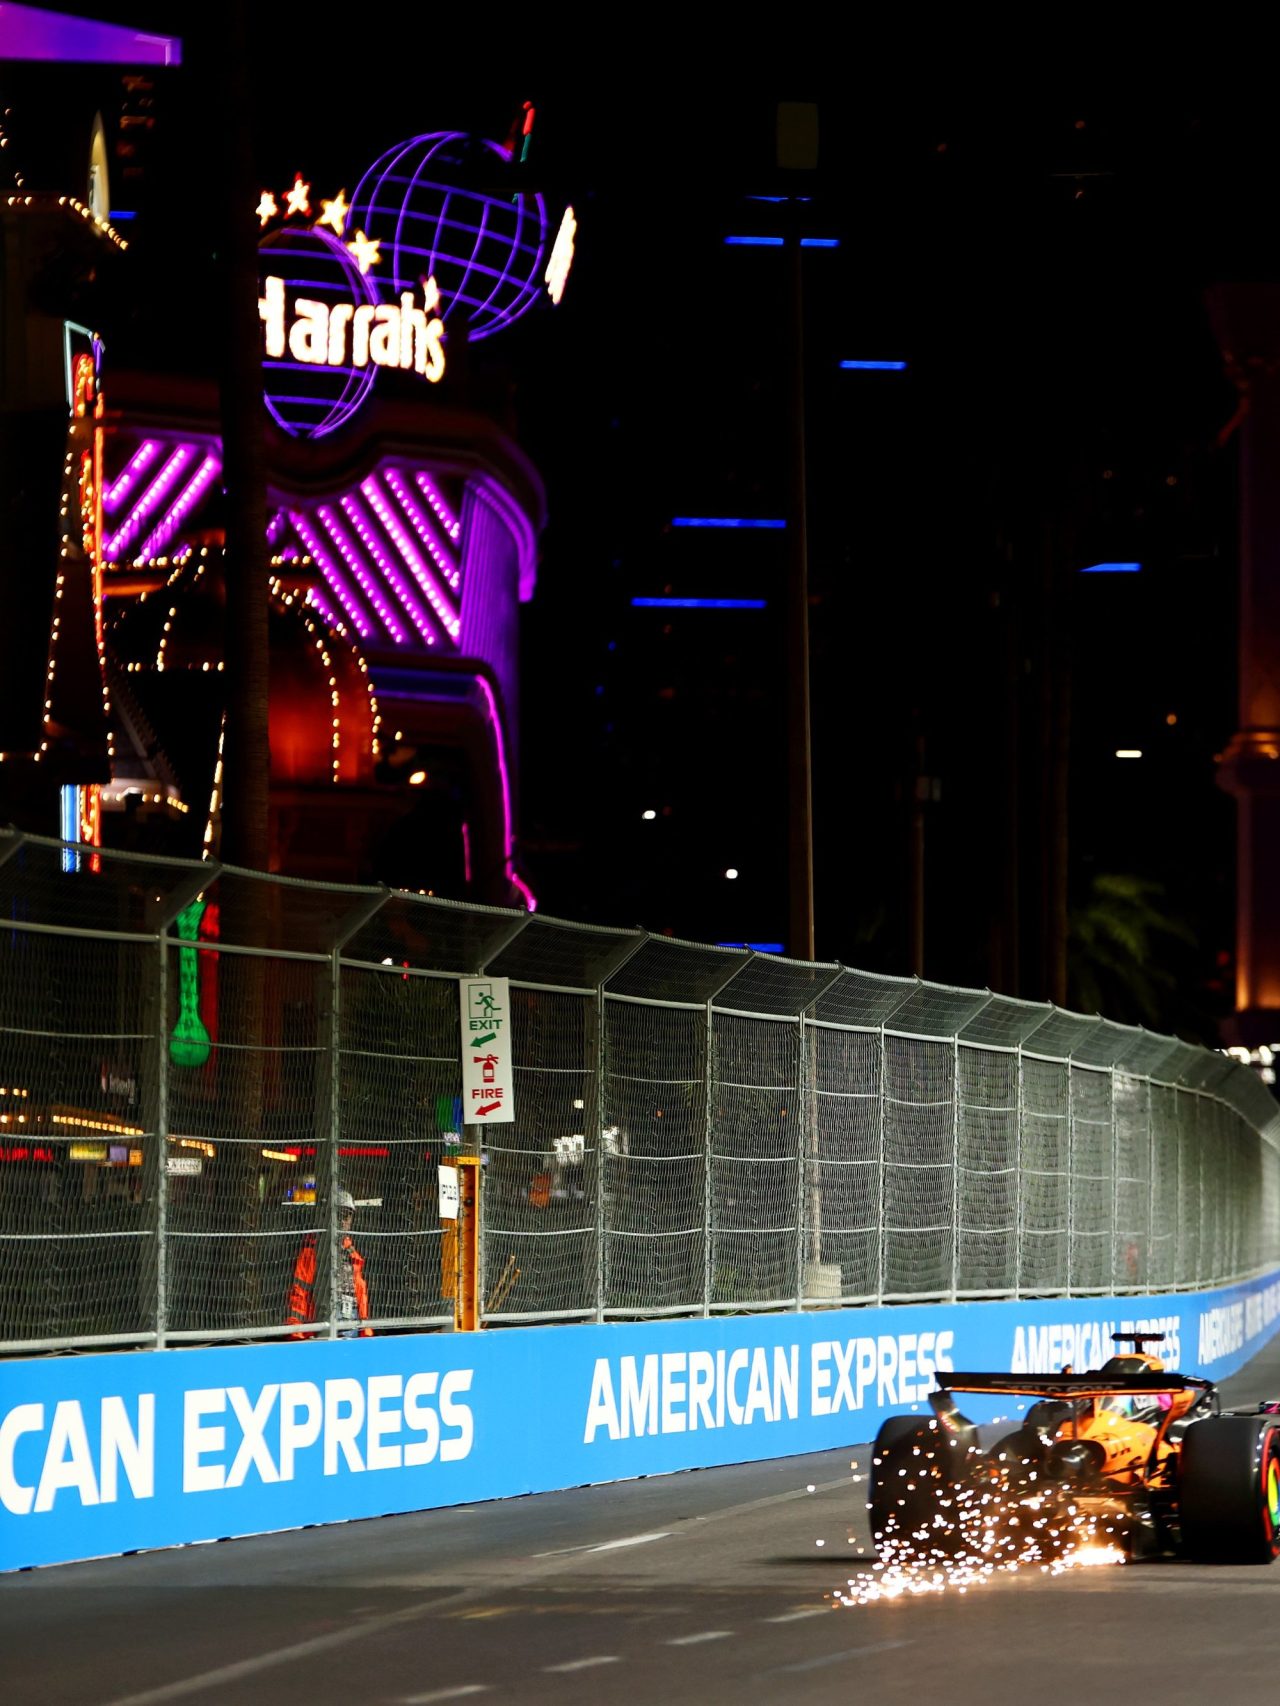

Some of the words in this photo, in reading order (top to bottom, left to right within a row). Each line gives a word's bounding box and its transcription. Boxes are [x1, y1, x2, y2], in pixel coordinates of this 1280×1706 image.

[469, 1019, 503, 1031] EXIT
[471, 1087, 504, 1100] FIRE
[1010, 1321, 1116, 1375] AMERICAN
[583, 1344, 800, 1444] AMERICAN
[811, 1331, 955, 1416] EXPRESS
[0, 1393, 156, 1515] CAN
[183, 1369, 475, 1493] EXPRESS
